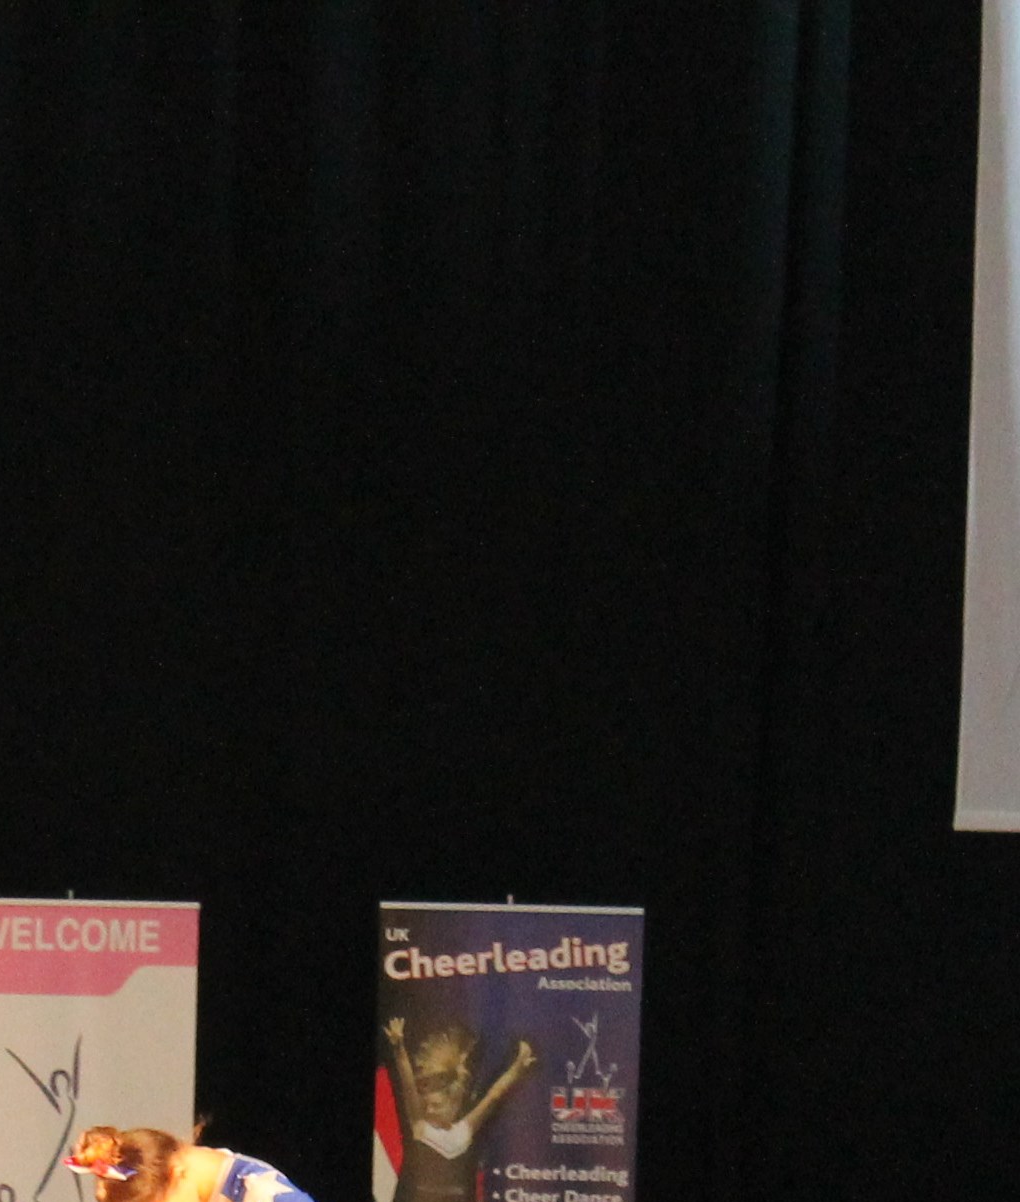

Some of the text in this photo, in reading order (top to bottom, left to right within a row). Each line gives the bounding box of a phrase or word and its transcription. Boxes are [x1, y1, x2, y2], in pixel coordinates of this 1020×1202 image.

[384, 927, 410, 942] UK
[383, 936, 631, 980] Cheerleading
[537, 976, 632, 992] Association
[504, 1164, 629, 1187] Cheerleading
